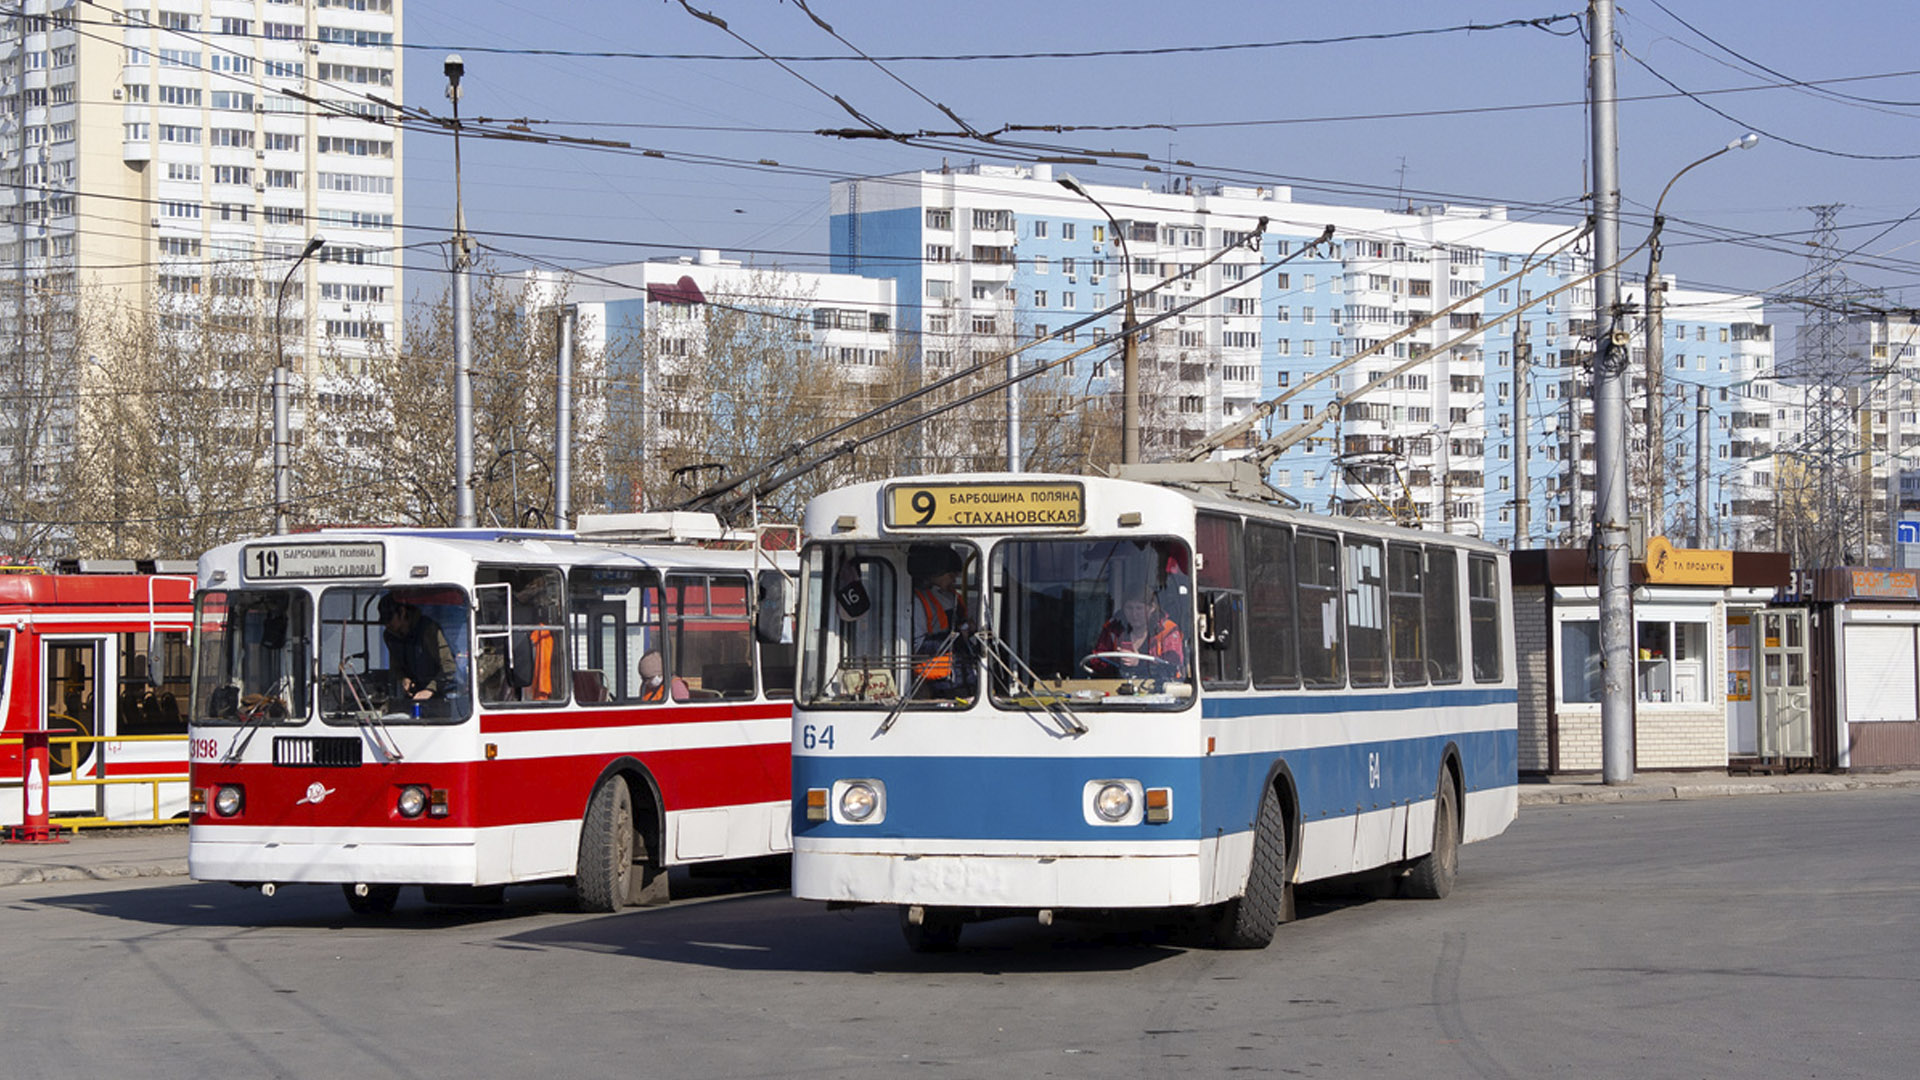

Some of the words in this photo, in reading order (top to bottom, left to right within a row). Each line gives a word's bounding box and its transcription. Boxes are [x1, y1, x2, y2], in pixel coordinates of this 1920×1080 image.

[911, 490, 937, 526] 9
[949, 493, 1025, 505] БАРБОШИНА
[1030, 491, 1080, 502] ПОЛЯНА
[953, 509, 1078, 524] СТАХАНОВСКАЯ
[256, 550, 279, 577] 19
[283, 549, 337, 560] БАРБОШИНА
[339, 548, 377, 558] ПОЛЯНА
[190, 738, 218, 759] 3198
[803, 725, 834, 750] 64
[1369, 751, 1380, 789] 64
